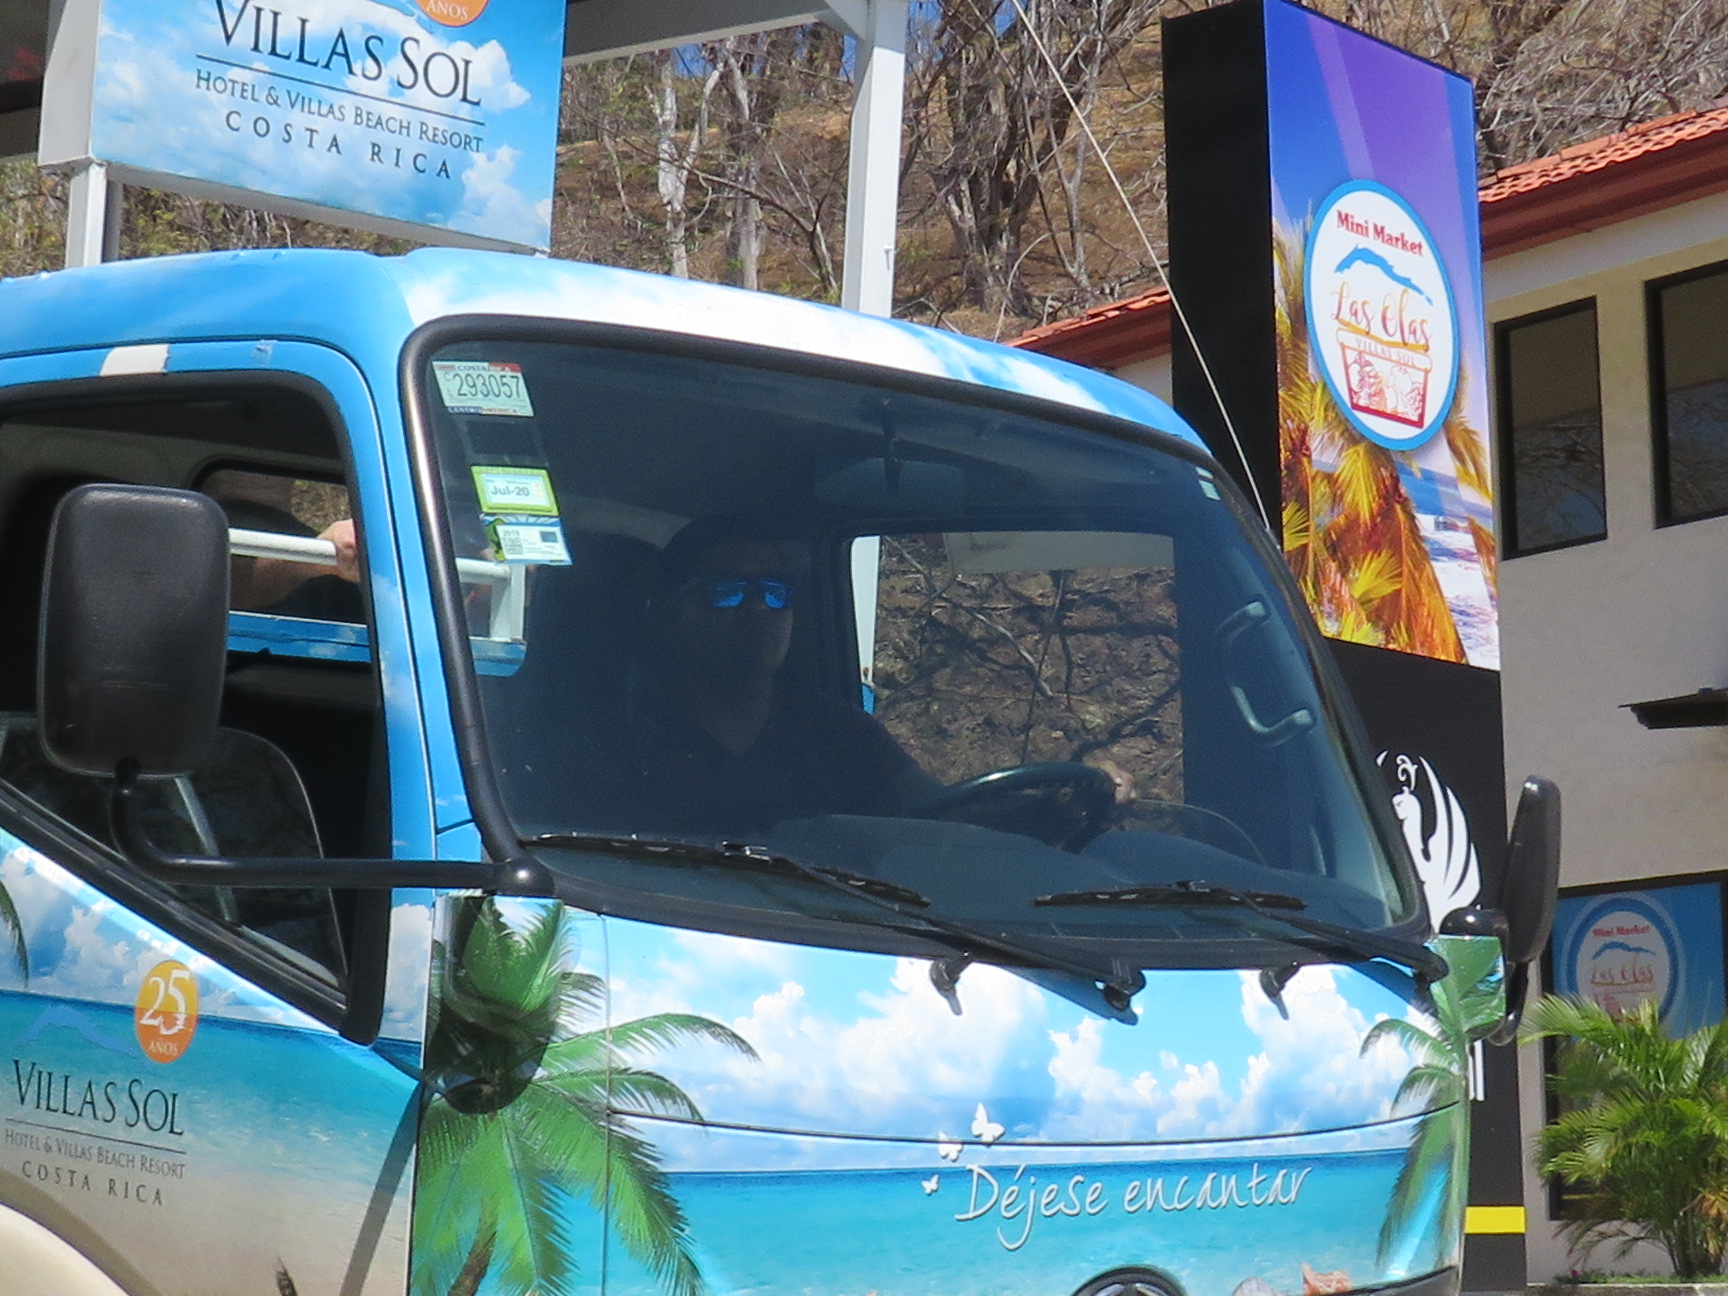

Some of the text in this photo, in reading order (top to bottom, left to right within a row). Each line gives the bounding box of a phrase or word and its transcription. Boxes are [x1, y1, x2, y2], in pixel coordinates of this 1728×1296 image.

[396, 35, 482, 106] SOL
[194, 67, 484, 154] HOTEL & VILLAS BEACH RESORT
[225, 109, 452, 180] COSTA RICA
[1336, 209, 1424, 257] Mini Market
[1330, 281, 1432, 353] Las Olas
[1355, 336, 1394, 360] VILLAS
[452, 373, 521, 398] 293057
[490, 485, 530, 497] Jul-20
[139, 969, 192, 1036] 25
[147, 1040, 179, 1055] AÑOS
[12, 1058, 185, 1137] VILLAS SOL
[4, 1128, 186, 1180] HOTEL & VILLAS BEACH RESORT
[22, 1160, 163, 1206] COSTA RICA
[954, 1160, 1312, 1250] Déjese encantar
